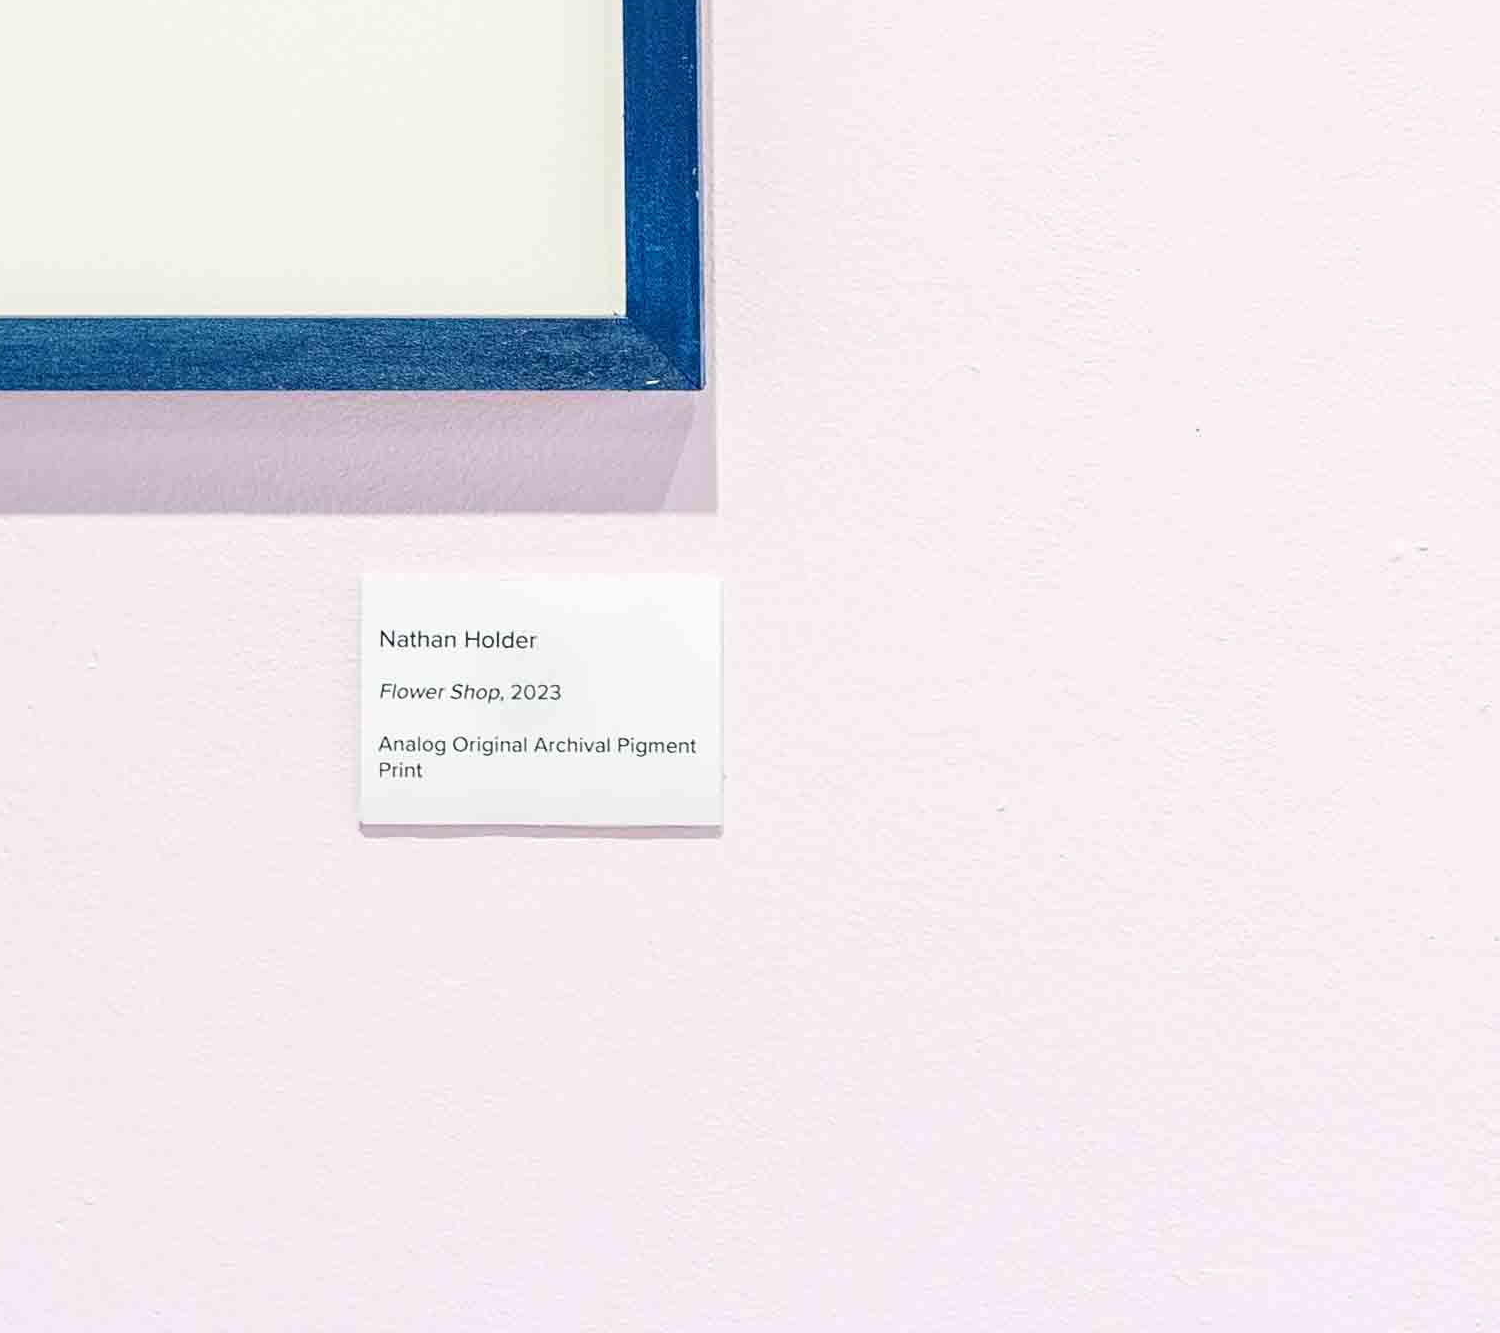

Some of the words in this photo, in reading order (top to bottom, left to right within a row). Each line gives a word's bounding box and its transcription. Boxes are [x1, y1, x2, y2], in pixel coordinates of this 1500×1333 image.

[379, 629, 457, 649] Nathan
[464, 630, 538, 650] Holder
[379, 683, 445, 700] Flower
[449, 683, 505, 704] Shop,
[510, 684, 562, 701] 2023
[377, 735, 446, 757] Analog
[452, 736, 528, 757] Original
[533, 736, 611, 754] Archival
[617, 736, 697, 758] Pigment
[379, 761, 423, 779] Print
